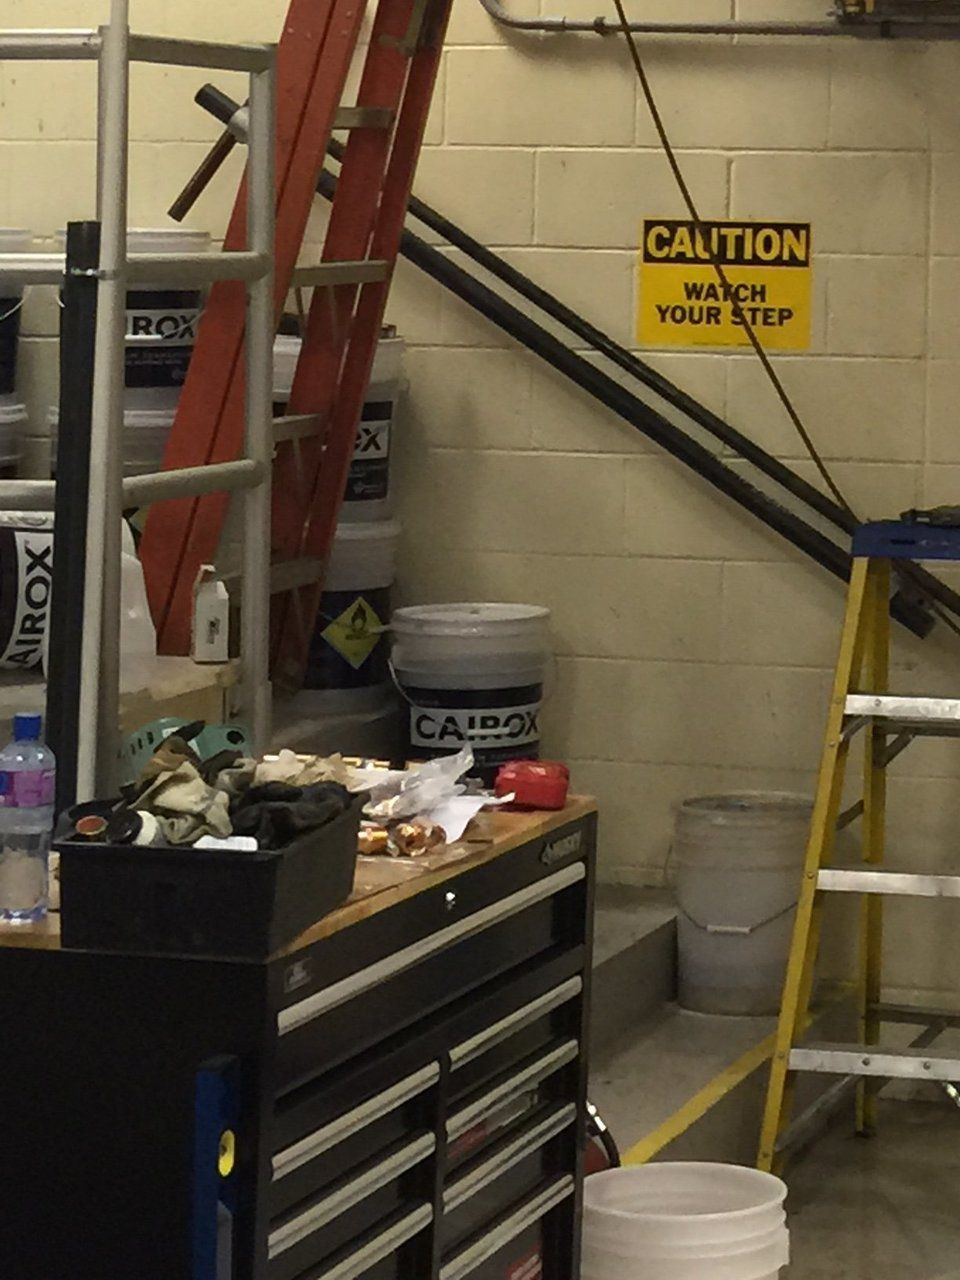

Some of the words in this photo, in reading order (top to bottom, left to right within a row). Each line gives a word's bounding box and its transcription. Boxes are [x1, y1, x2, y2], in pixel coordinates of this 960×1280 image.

[647, 226, 806, 261] CAUTION
[684, 283, 766, 303] WATCH
[656, 305, 721, 325] YOUR
[731, 308, 793, 326] STEP
[416, 712, 538, 741] CAIROX
